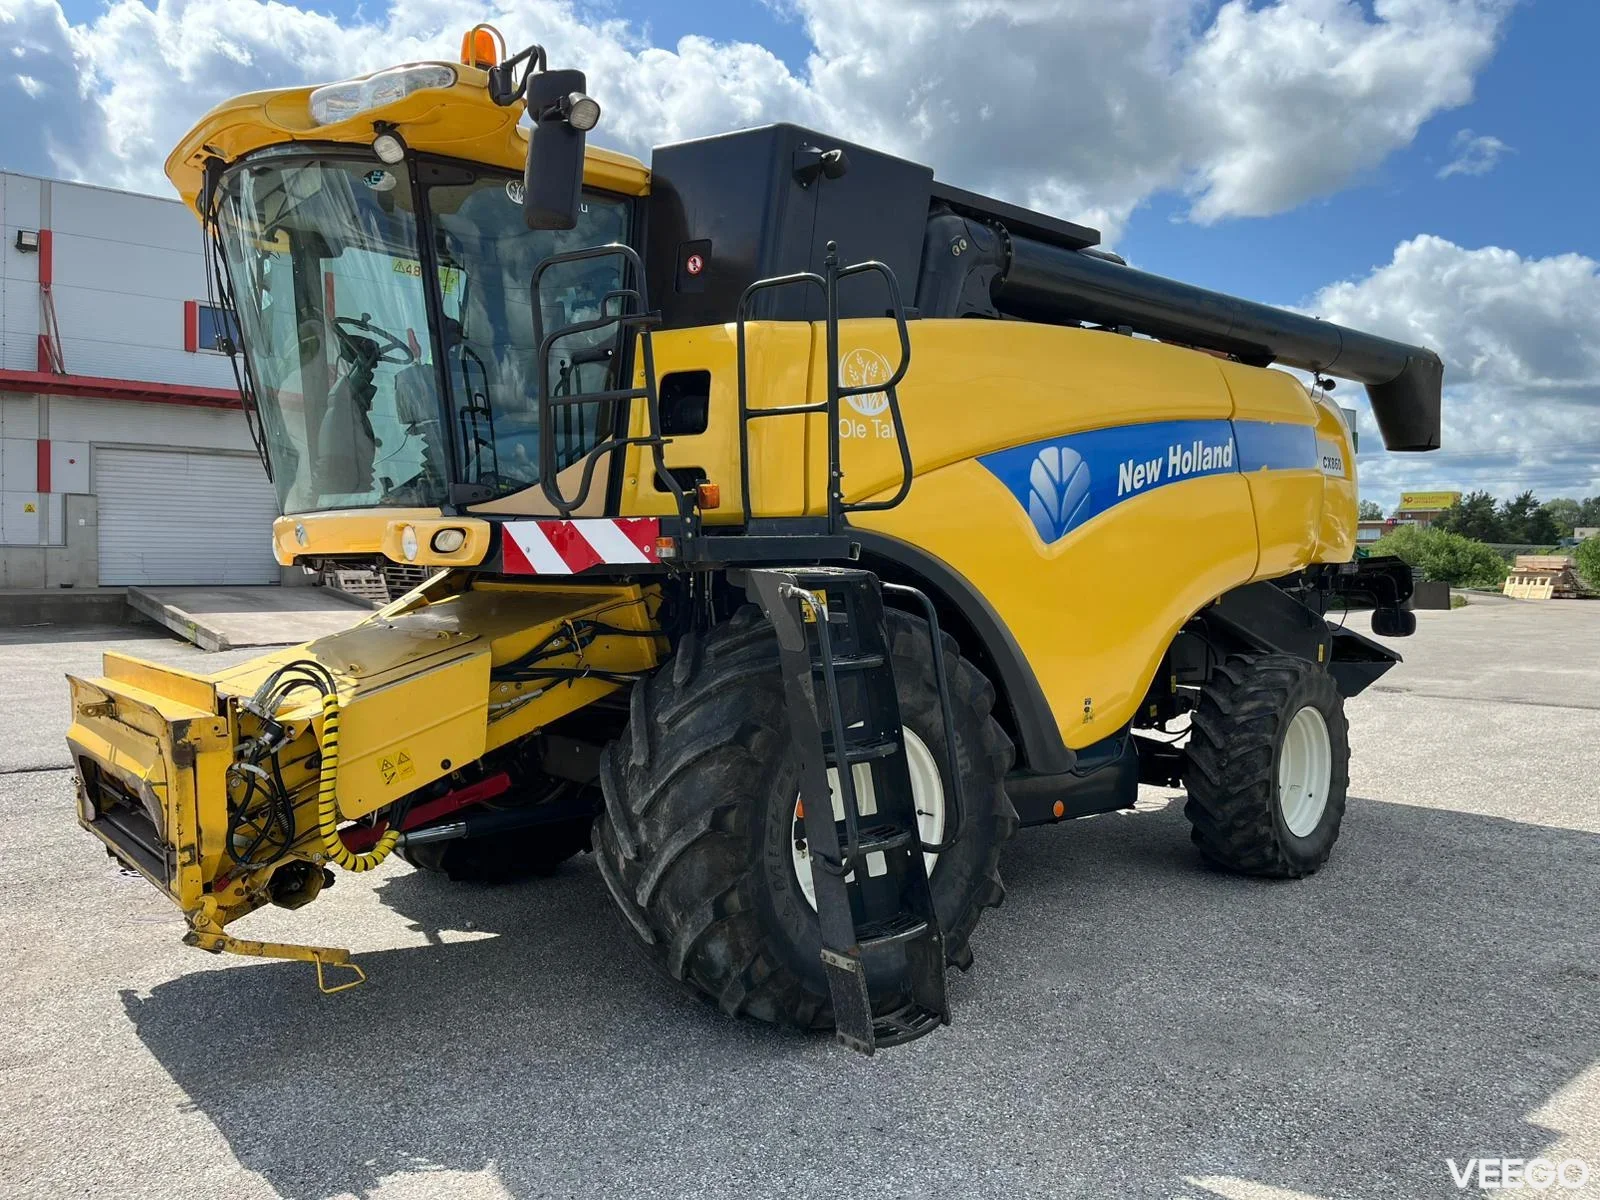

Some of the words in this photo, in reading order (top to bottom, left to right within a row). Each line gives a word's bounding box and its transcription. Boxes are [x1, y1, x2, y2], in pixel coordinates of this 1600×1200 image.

[839, 418, 866, 438] Ole
[871, 419, 898, 438] Tal
[1117, 457, 1163, 497] New
[1167, 437, 1233, 478] Holland
[1322, 456, 1342, 471] CX860
